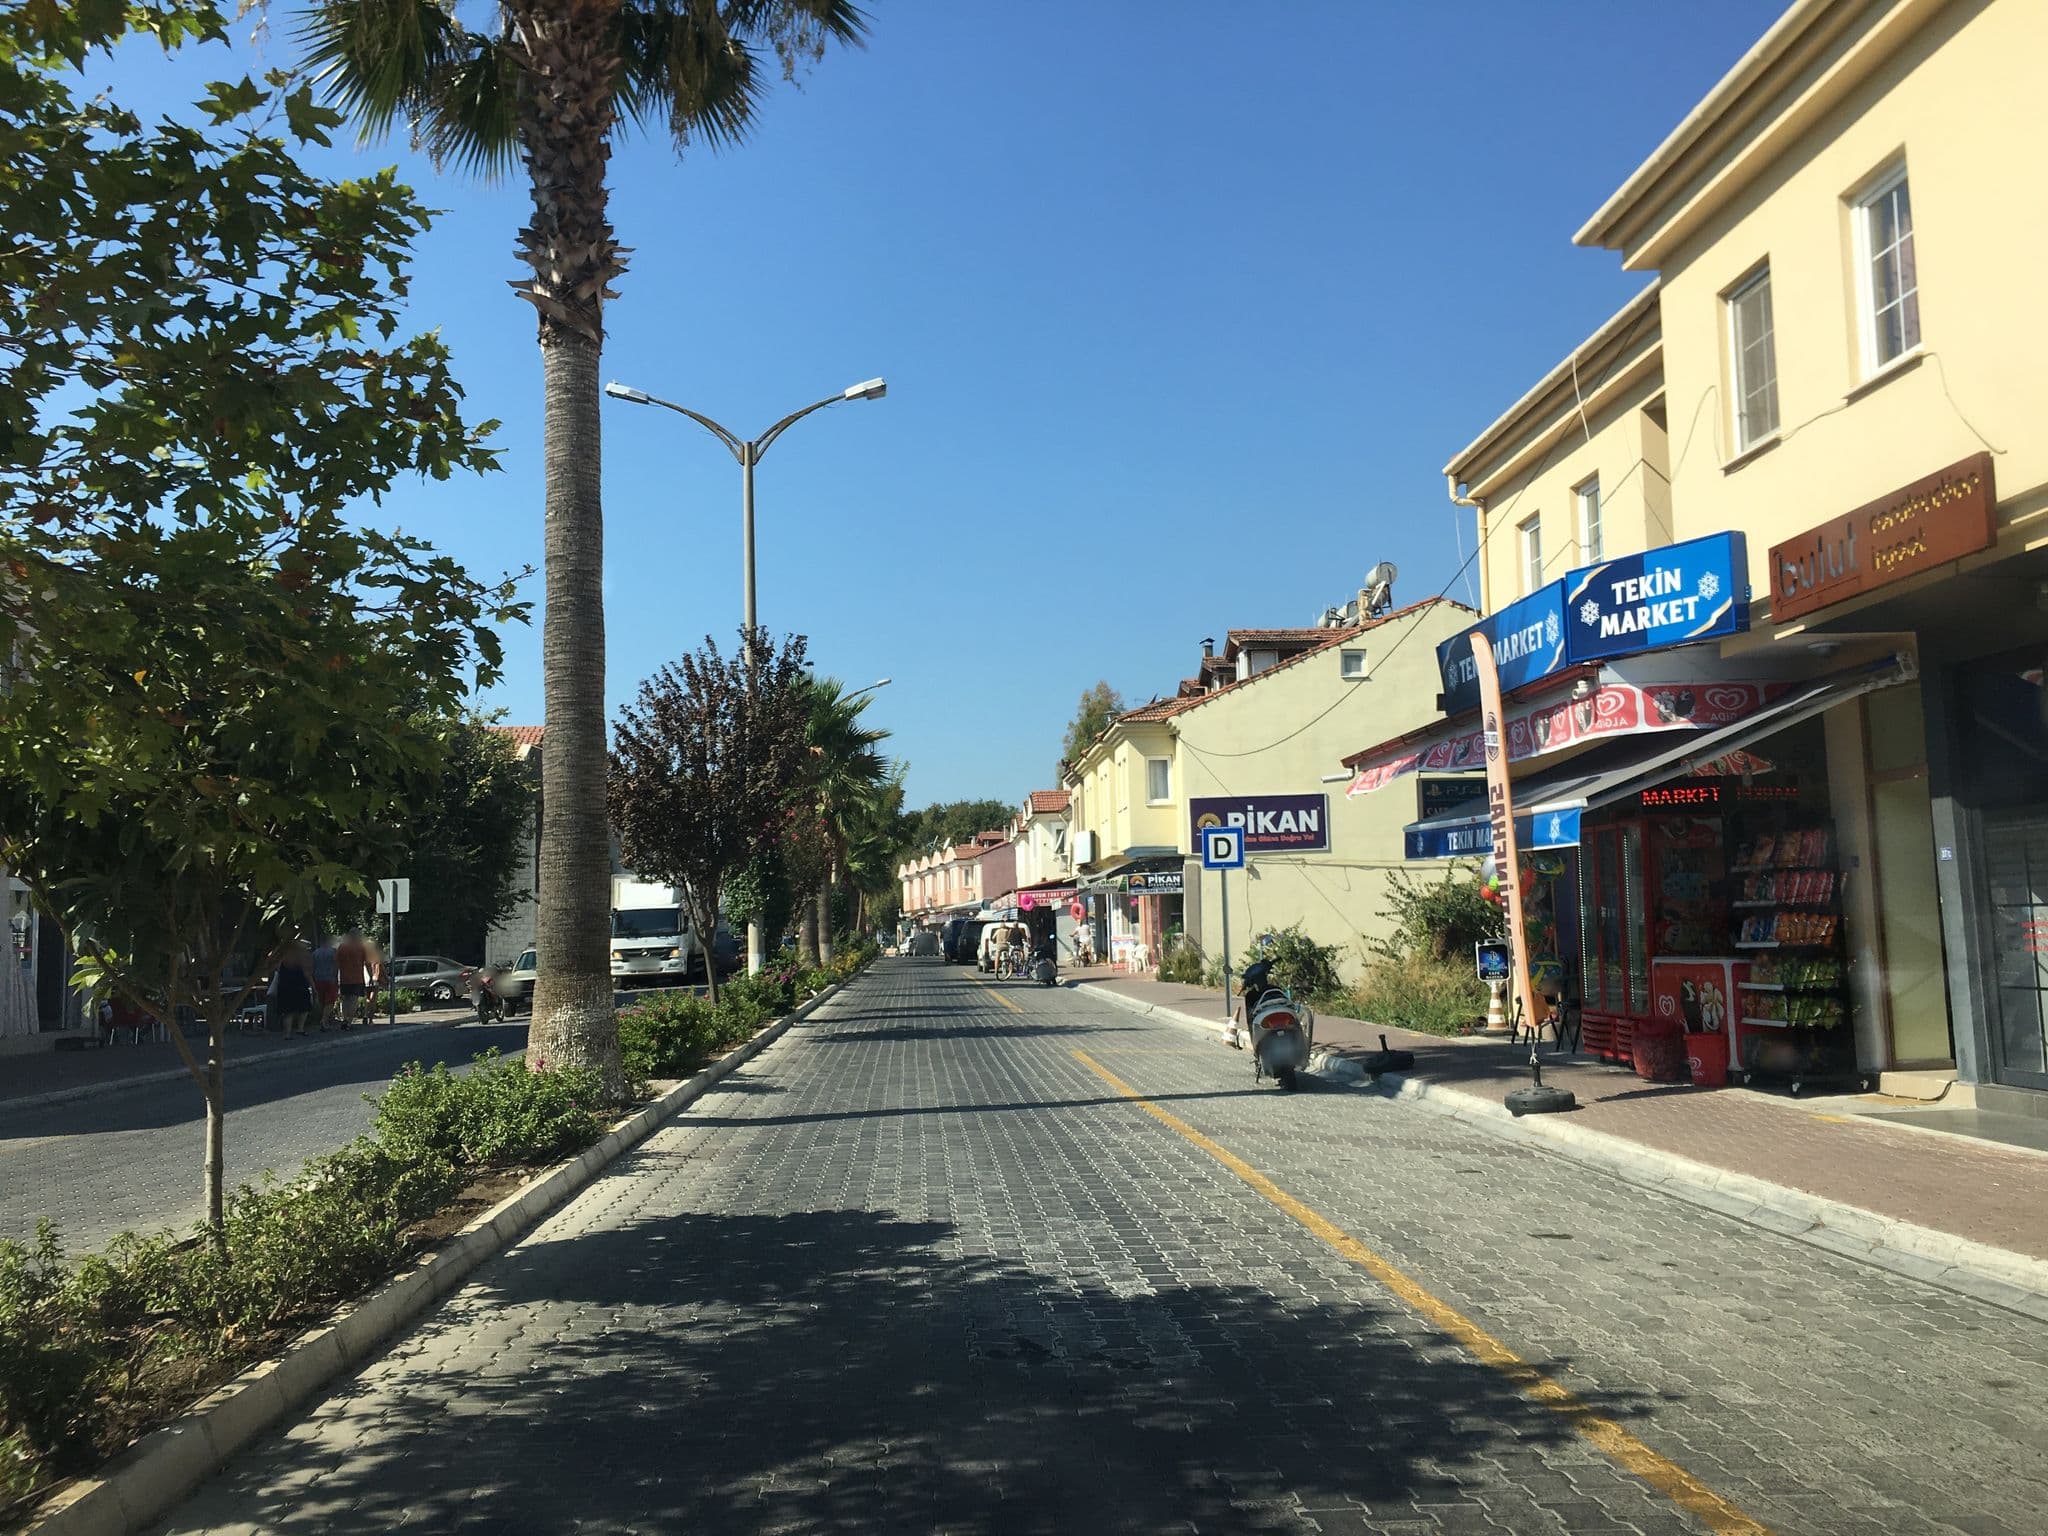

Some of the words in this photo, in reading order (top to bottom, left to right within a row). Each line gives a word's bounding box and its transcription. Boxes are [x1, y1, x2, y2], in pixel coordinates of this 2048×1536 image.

[1773, 521, 1857, 597] bulut
[1611, 567, 1682, 605] TEKİN
[1600, 595, 1699, 638] MARKET
[1492, 621, 1544, 665] MARKET
[1227, 805, 1319, 834] PİKAN
[1213, 837, 1232, 859] D
[1447, 825, 1474, 851] TEKİN
[1147, 873, 1181, 884] PİKAN
